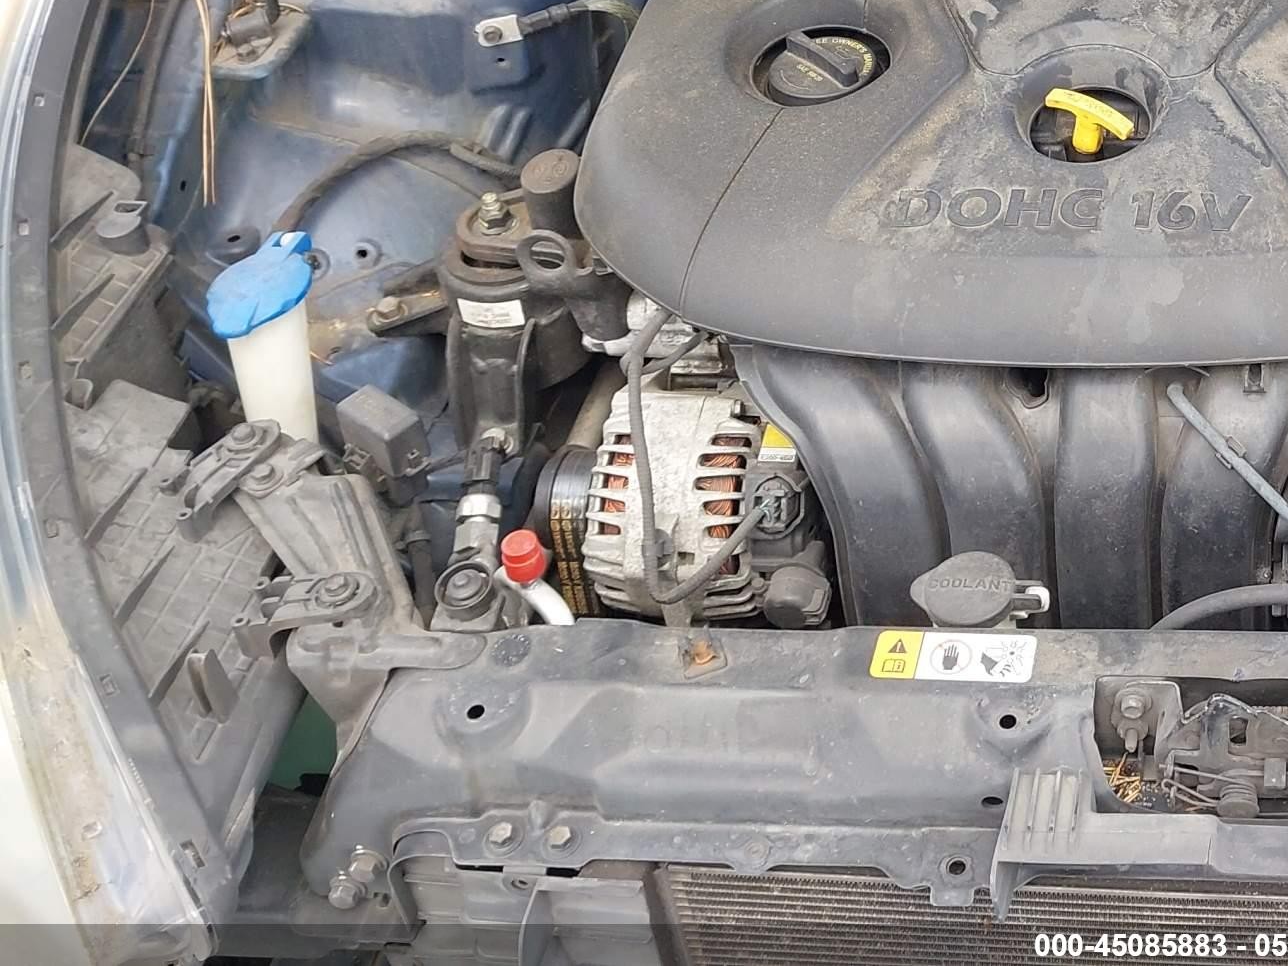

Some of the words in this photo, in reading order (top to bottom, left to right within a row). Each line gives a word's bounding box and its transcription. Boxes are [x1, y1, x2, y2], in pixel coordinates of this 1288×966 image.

[896, 187, 1105, 230] DOHC
[1130, 189, 1252, 232] 16V
[928, 577, 1012, 593] COOLANT
